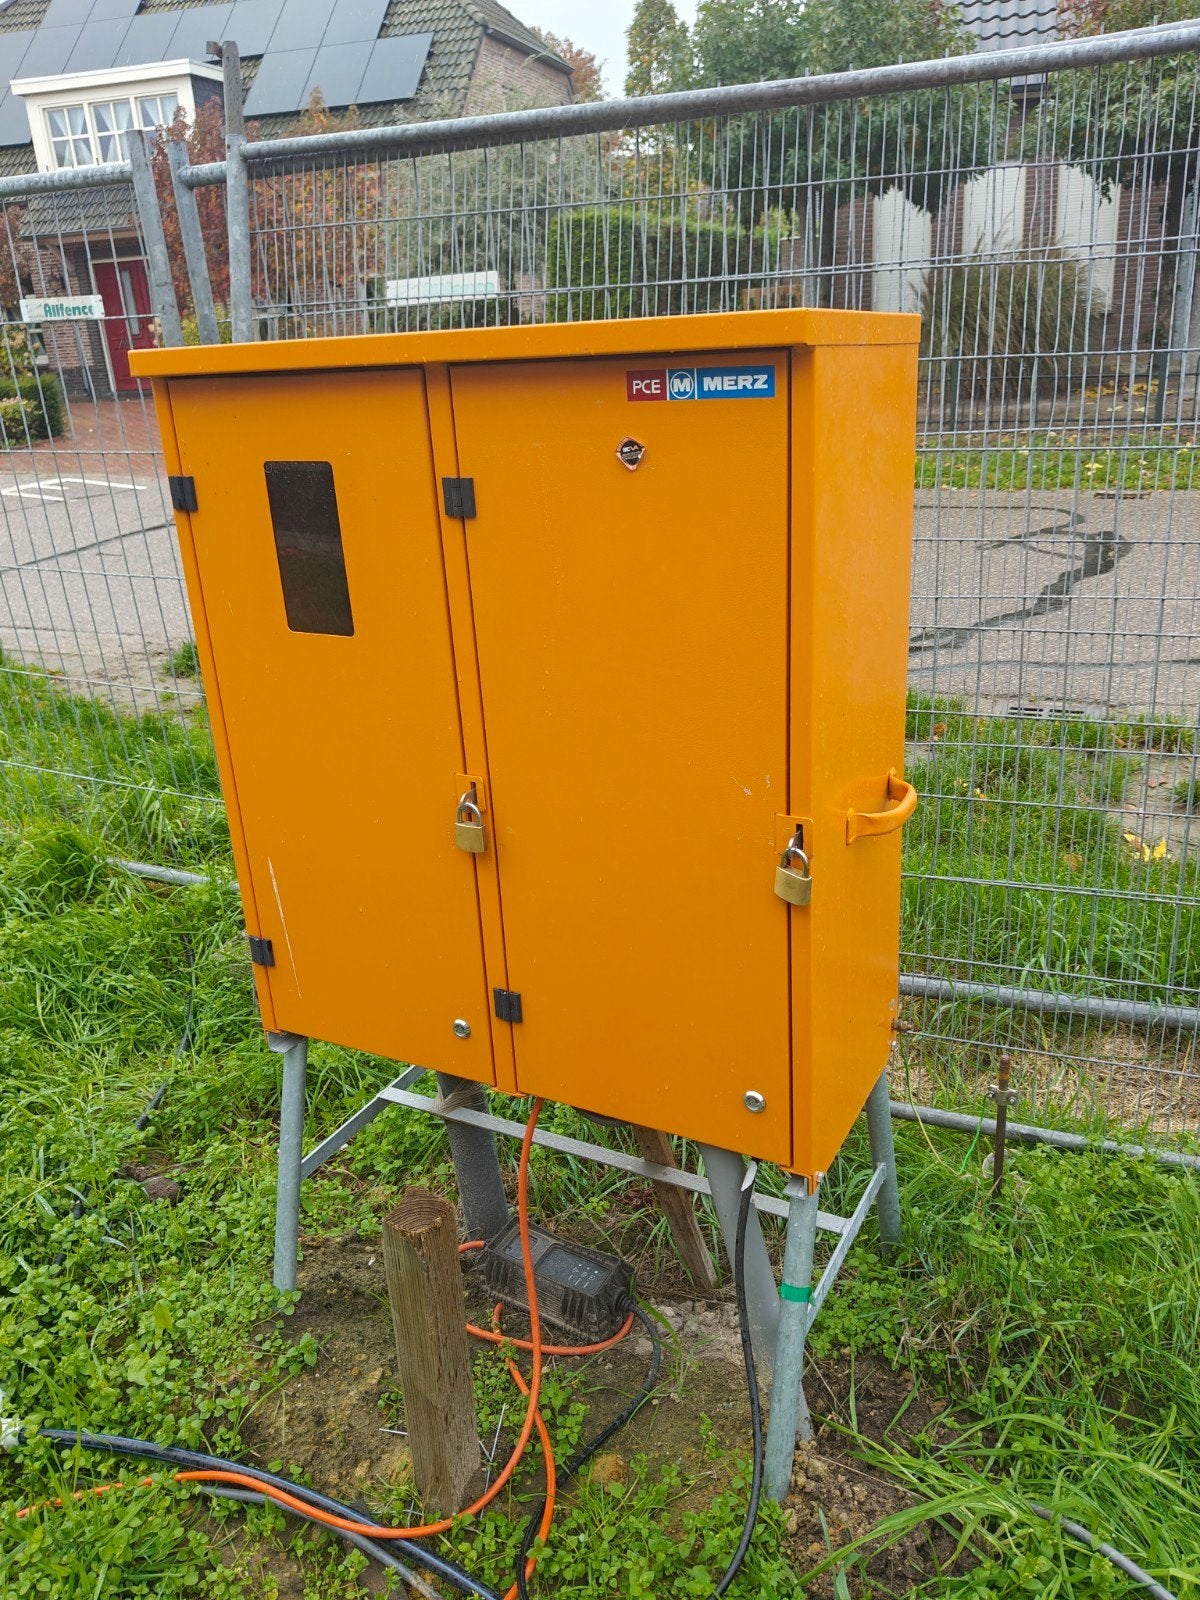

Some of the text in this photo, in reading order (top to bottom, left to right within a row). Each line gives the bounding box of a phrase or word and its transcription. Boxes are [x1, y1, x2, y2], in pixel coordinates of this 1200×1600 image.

[632, 374, 768, 395] PCE M MERZ
